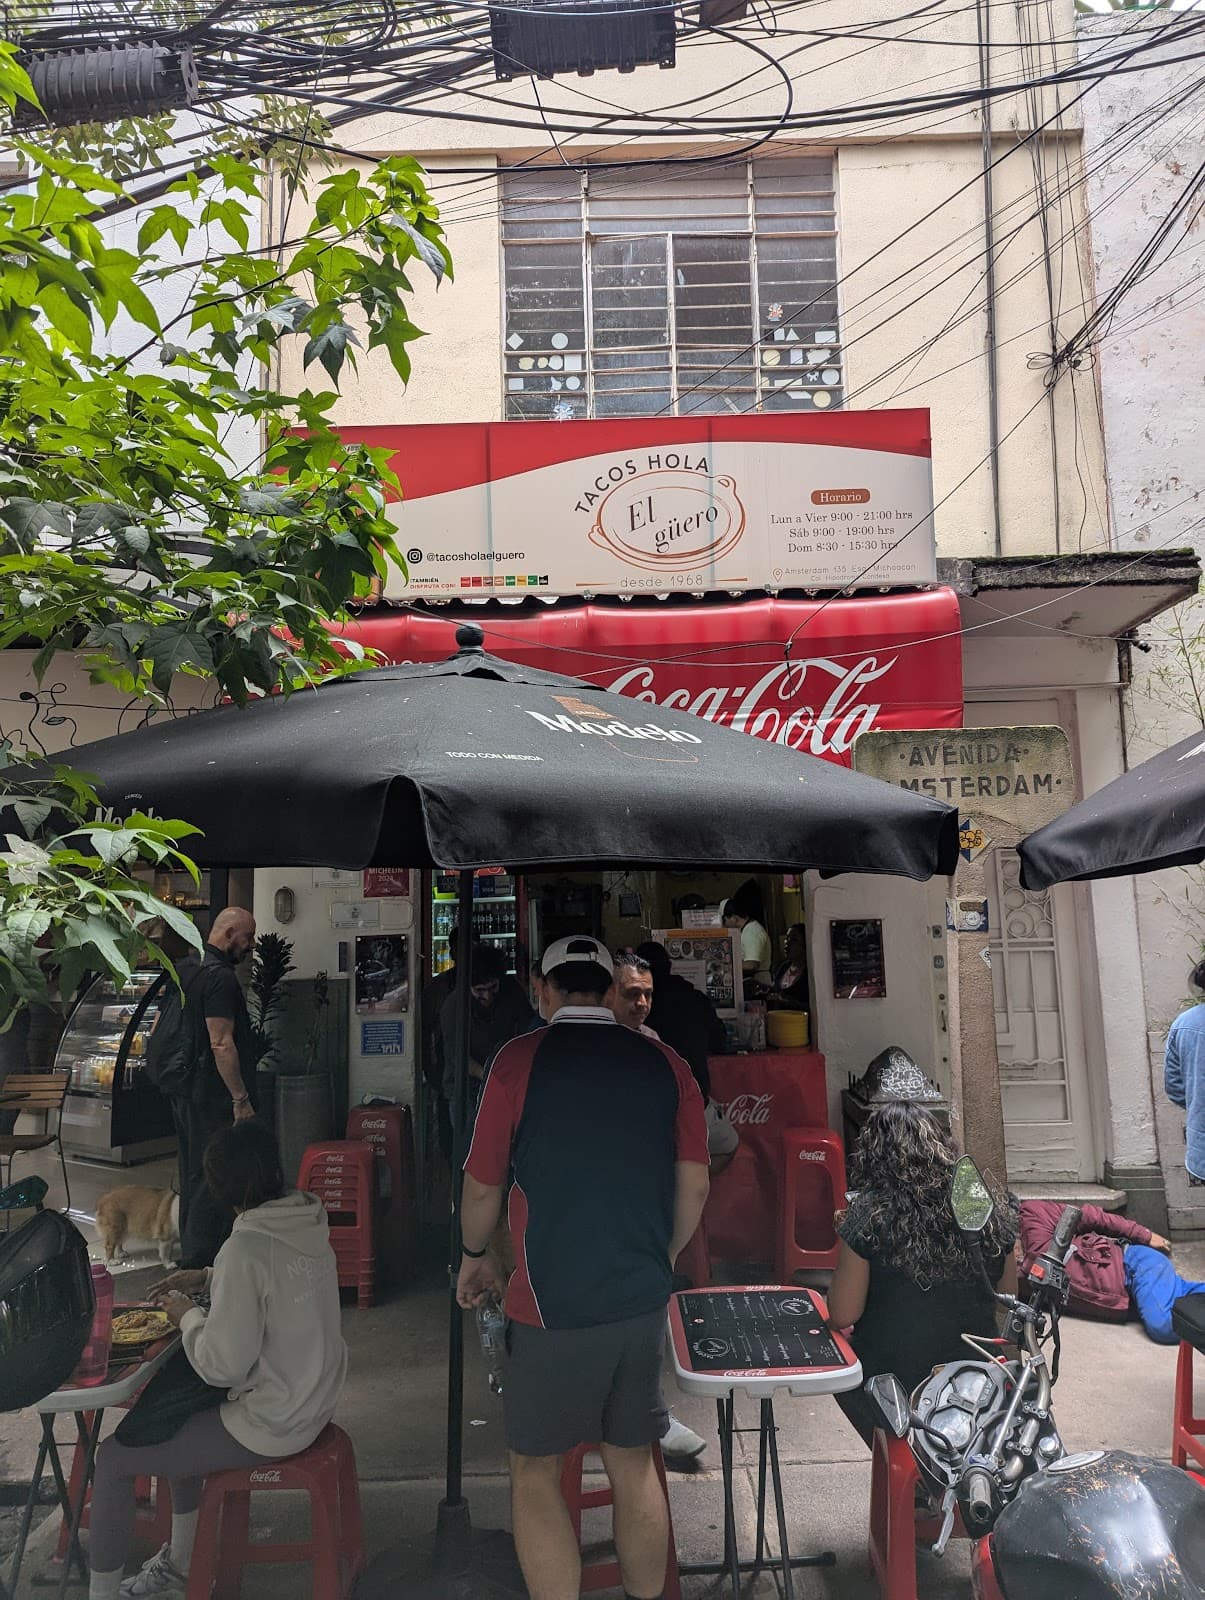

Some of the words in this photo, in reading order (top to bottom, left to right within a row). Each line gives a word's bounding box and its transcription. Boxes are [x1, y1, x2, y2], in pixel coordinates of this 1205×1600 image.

[574, 459, 637, 513] TACOS
[648, 453, 709, 473] HOLA
[820, 491, 862, 503] Horario
[627, 495, 656, 532] El
[770, 514, 793, 524] Lun
[805, 512, 828, 523] Vier
[830, 512, 853, 522] 9:00
[863, 511, 892, 521] 21:00
[895, 510, 913, 520] hrs
[655, 506, 718, 553] güero
[789, 527, 810, 538] Sáb
[812, 527, 836, 537] 9:00
[846, 526, 875, 536] 19:00
[877, 525, 895, 535] hrs
[788, 542, 812, 552] Dom
[816, 542, 839, 552] 8:30
[849, 541, 878, 551] 15:30
[426, 550, 525, 563] @tacosholaelguero
[620, 576, 662, 588] desde
[670, 575, 704, 587] 1968
[525, 710, 702, 744] Modelo
[445, 751, 476, 759] TODO
[478, 752, 502, 760] CON
[502, 753, 545, 762] MEDIDA
[908, 743, 1020, 767] AVENIDA
[886, 774, 1052, 797] MSTERDAM
